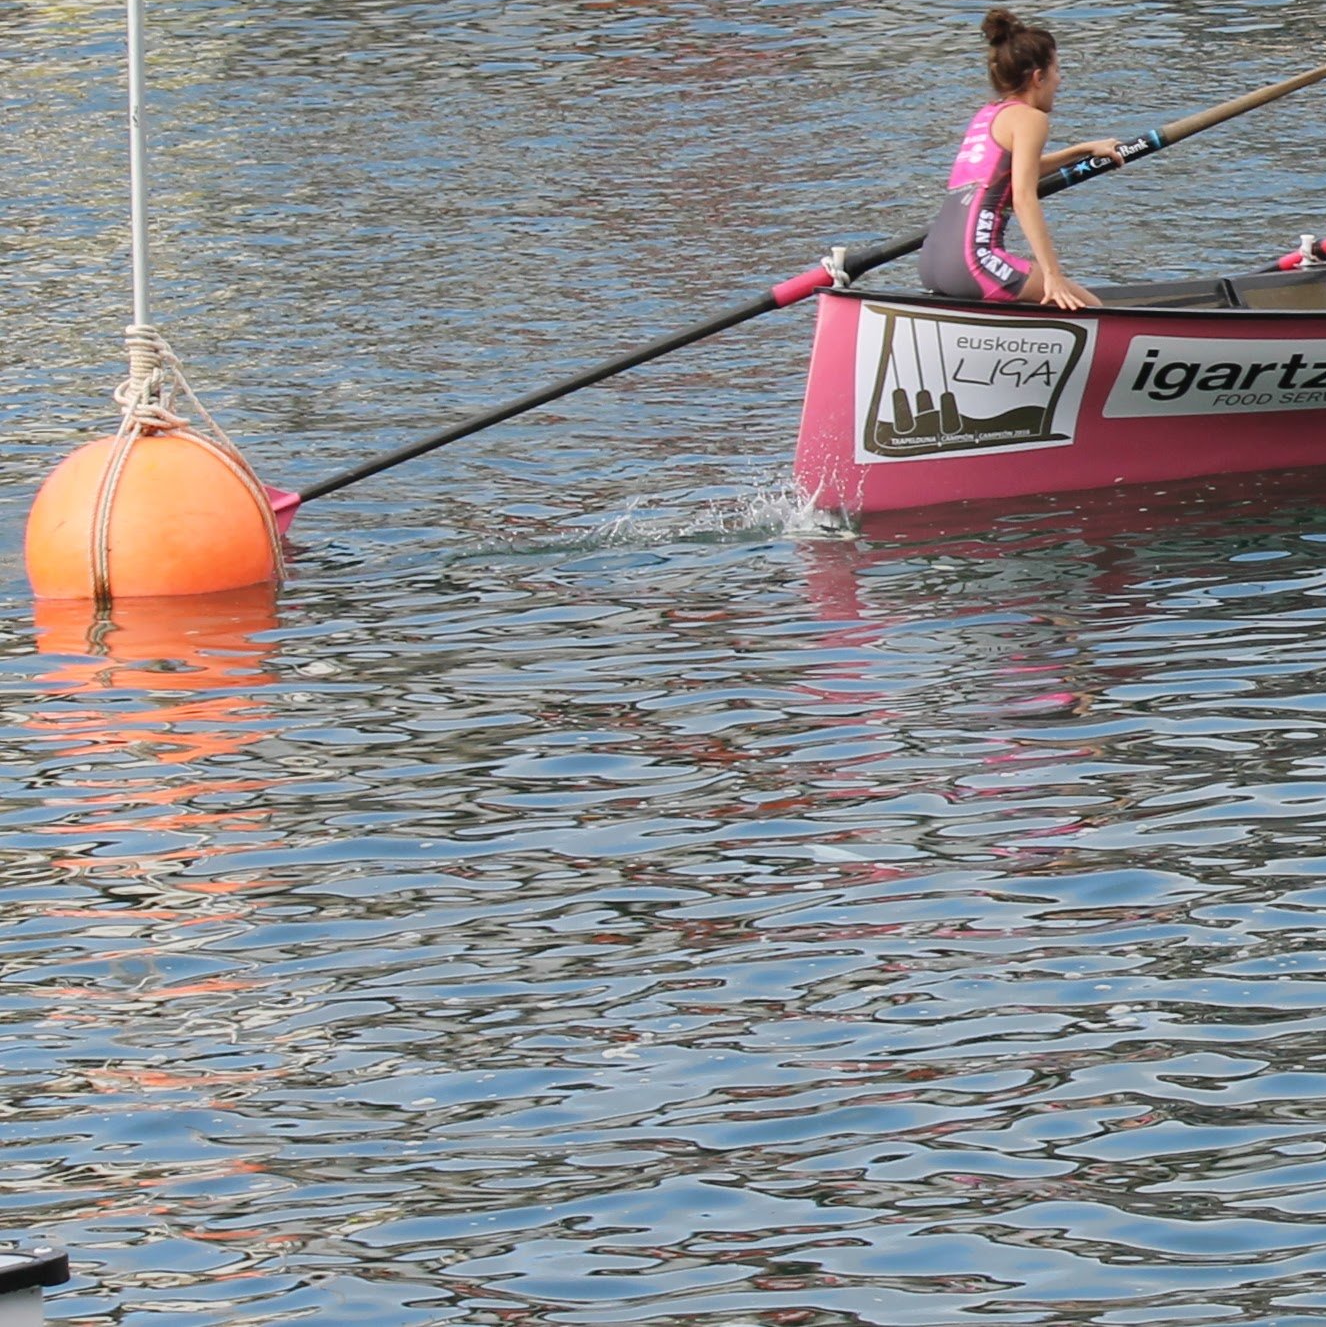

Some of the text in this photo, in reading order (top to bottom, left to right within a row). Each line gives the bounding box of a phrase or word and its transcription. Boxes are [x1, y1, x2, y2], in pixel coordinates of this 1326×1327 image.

[957, 336, 1062, 354] euskotren
[953, 358, 1056, 387] LIGA
[1213, 392, 1273, 405] FOOD
